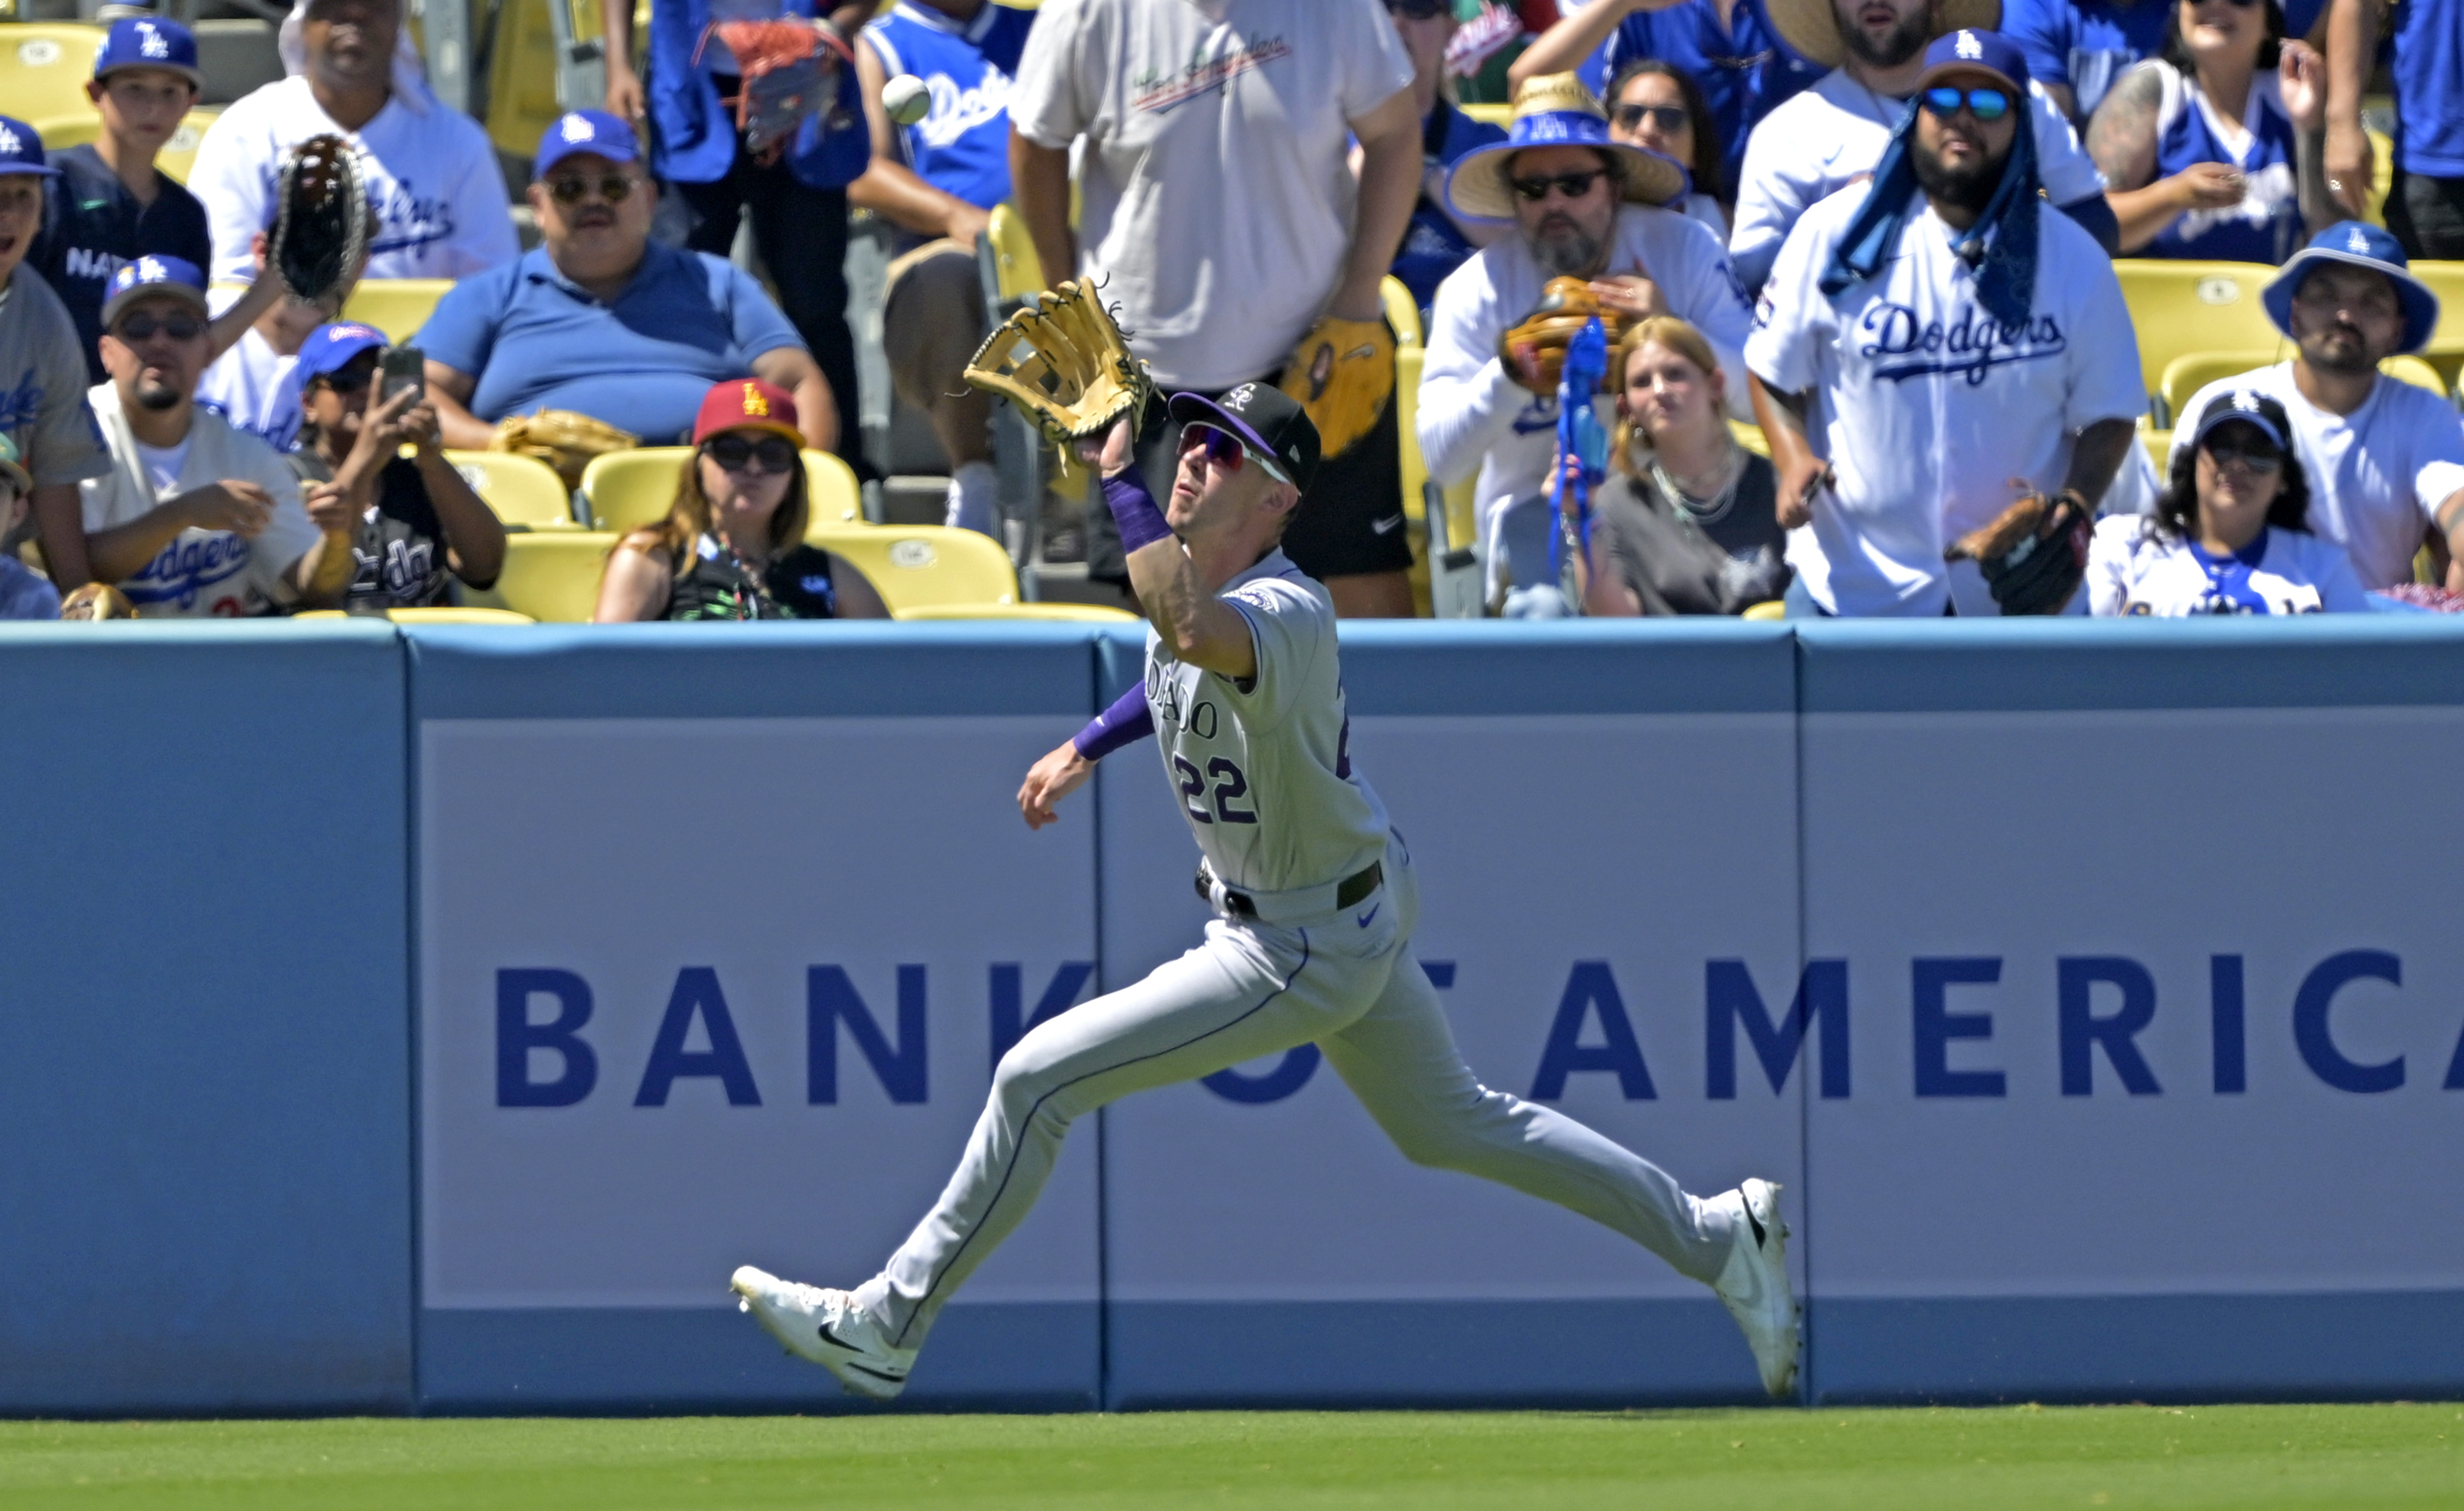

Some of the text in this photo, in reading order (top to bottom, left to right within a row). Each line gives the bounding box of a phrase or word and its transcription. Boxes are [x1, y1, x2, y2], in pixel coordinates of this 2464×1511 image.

[1955, 29, 1982, 59] LA
[1862, 302, 2066, 386] Dodgers
[742, 383, 769, 416] LA
[1173, 751, 1258, 824] 22
[1526, 948, 2464, 1101] AMERIC
